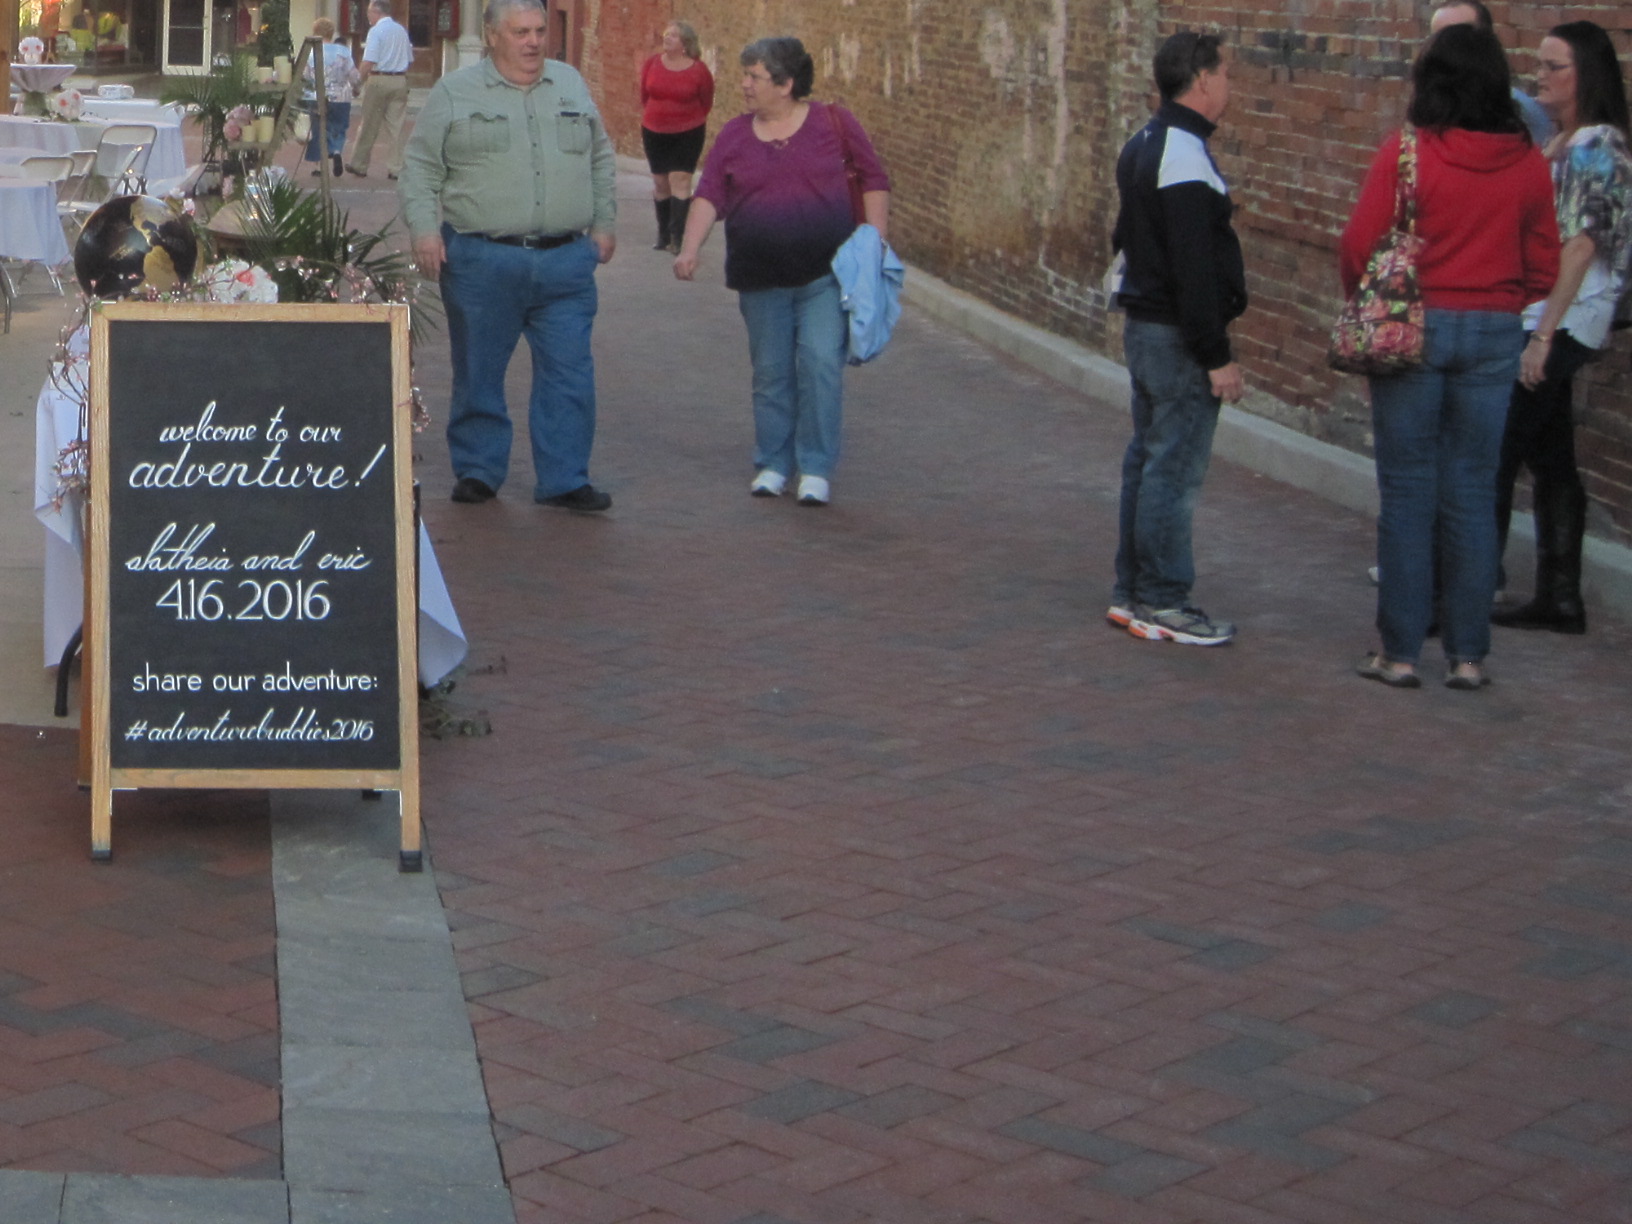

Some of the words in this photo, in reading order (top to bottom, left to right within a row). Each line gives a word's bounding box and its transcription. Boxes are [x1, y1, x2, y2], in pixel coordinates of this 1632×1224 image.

[159, 400, 257, 443] welcome
[266, 405, 290, 443] to
[299, 424, 342, 443] our
[129, 442, 387, 489] adventure!
[241, 530, 316, 571] and
[317, 546, 373, 571] eric
[155, 578, 331, 621] 4.16.2016
[132, 661, 203, 692] share
[212, 673, 256, 692] our
[262, 660, 379, 692] adventure:
[124, 706, 375, 742] #adventurebuddies2016
